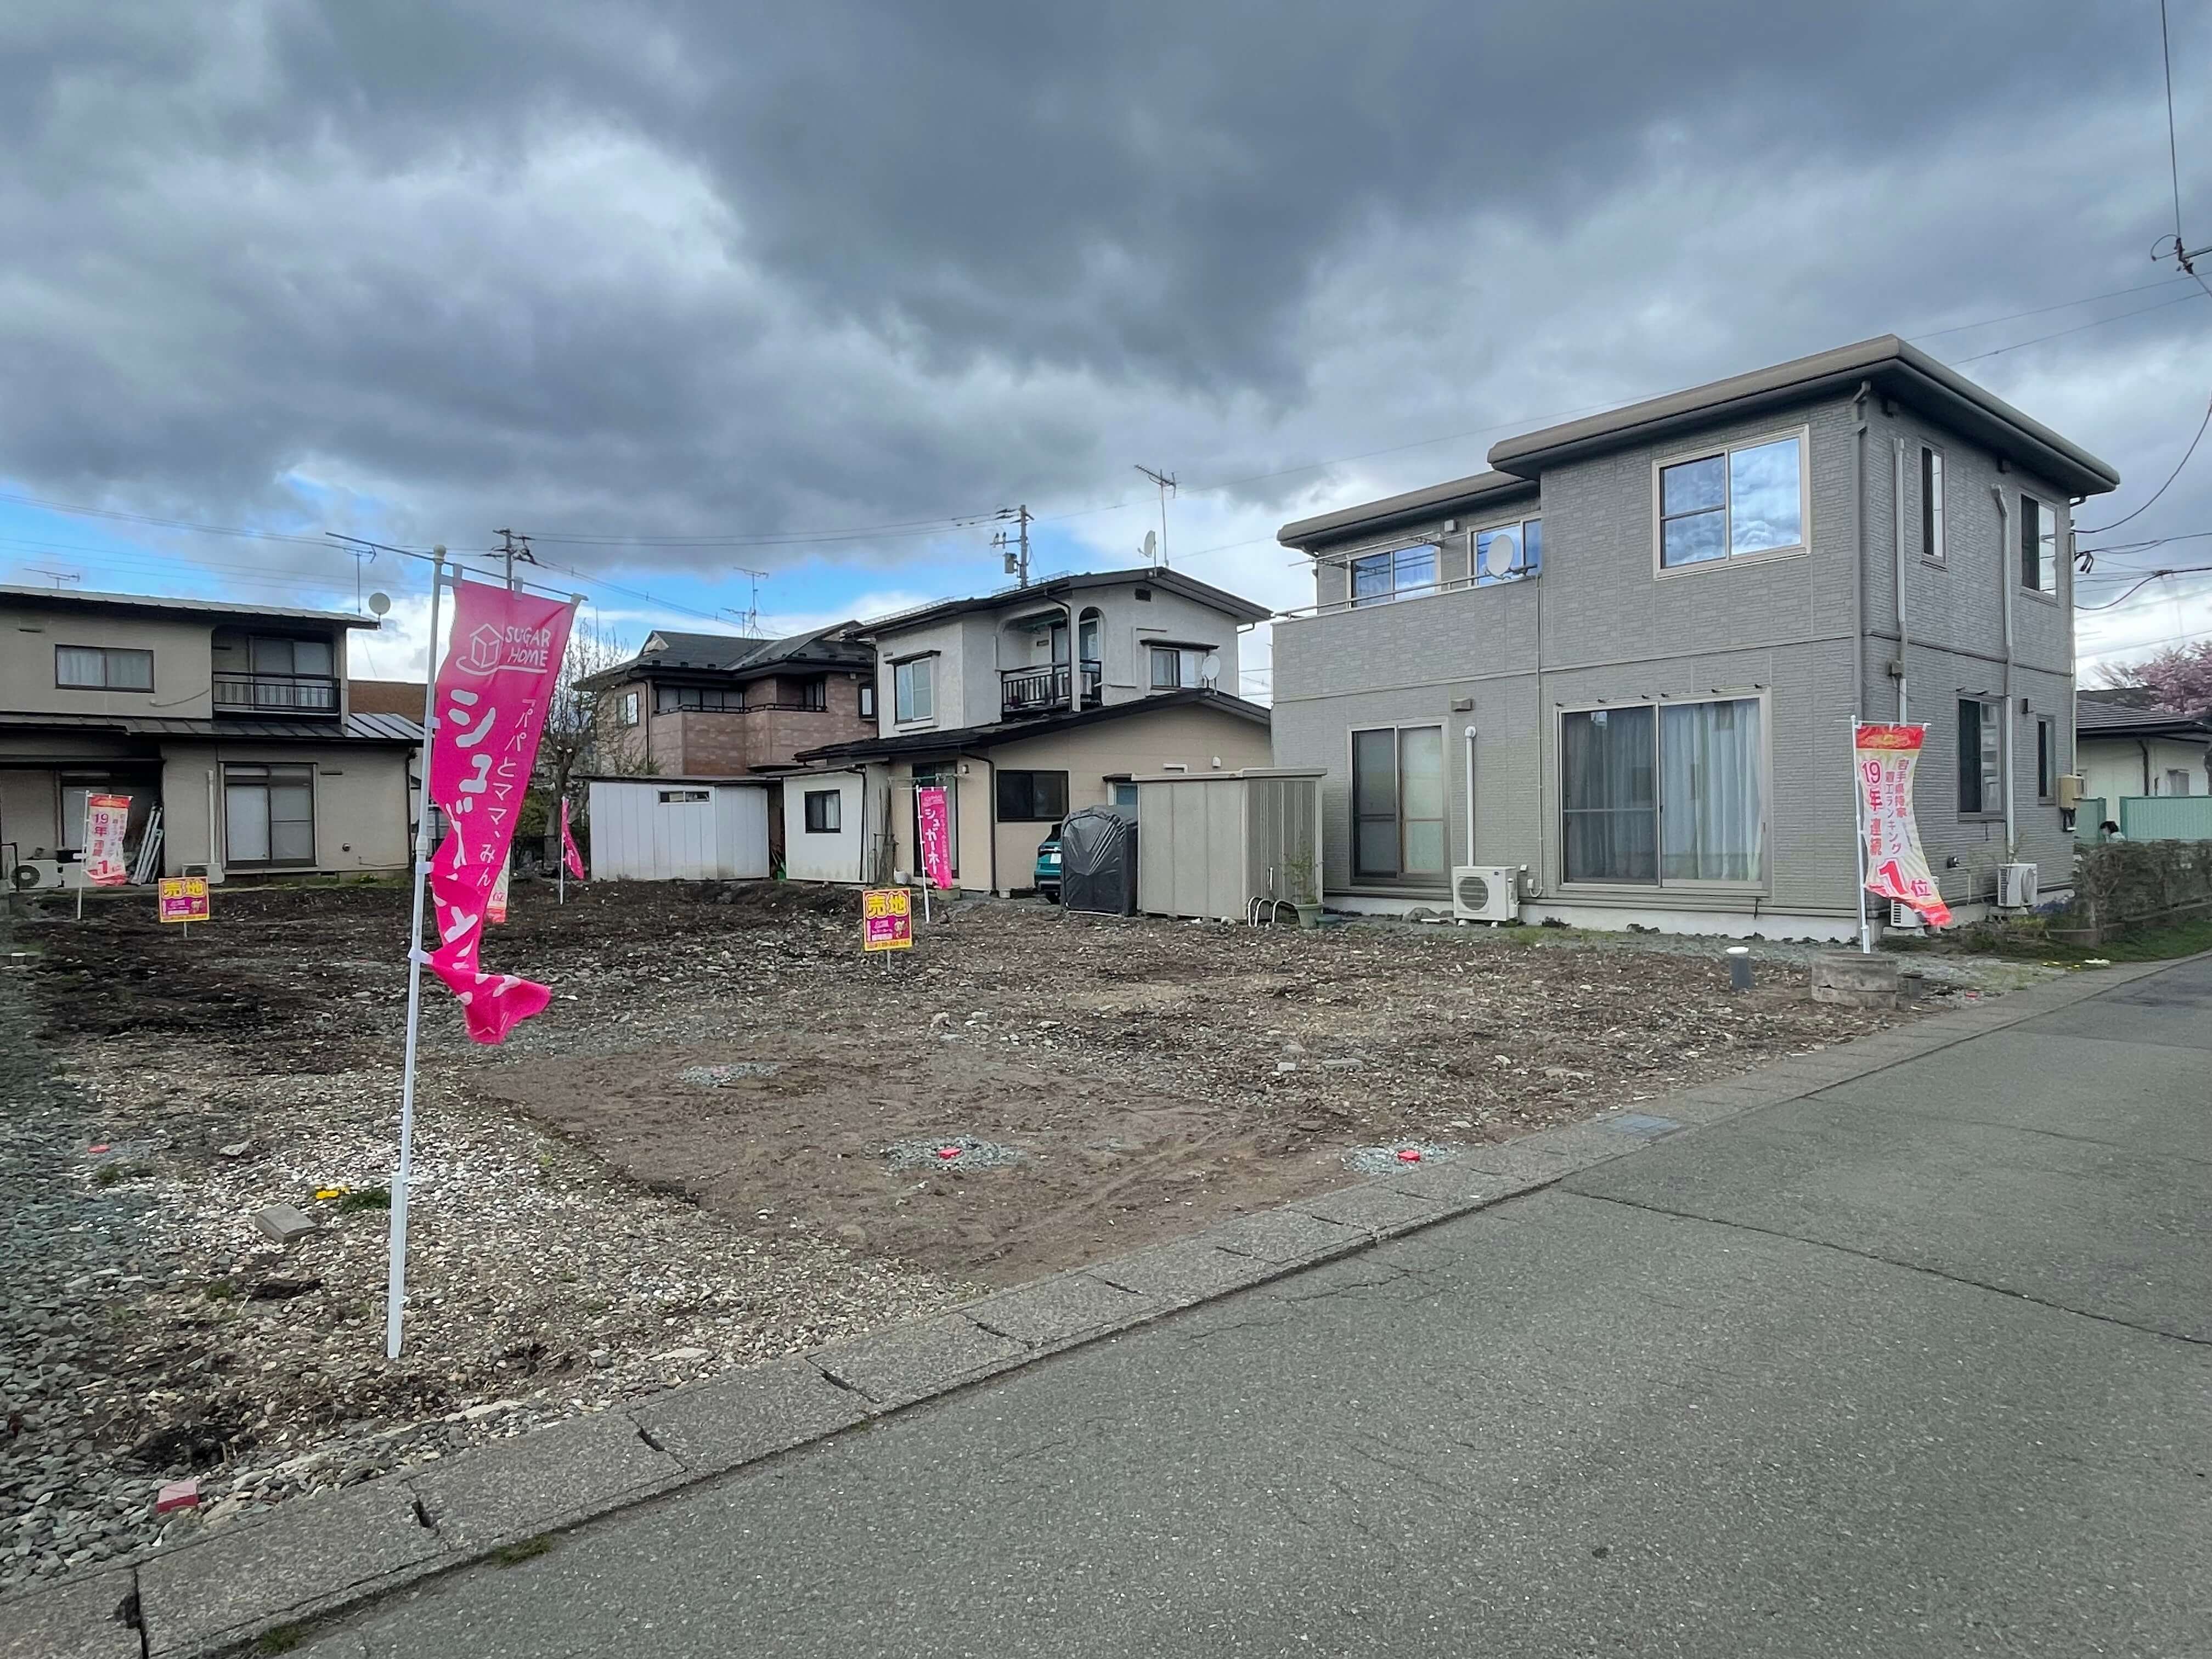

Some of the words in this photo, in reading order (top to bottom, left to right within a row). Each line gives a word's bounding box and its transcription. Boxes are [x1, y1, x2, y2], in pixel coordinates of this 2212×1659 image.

[504, 626, 551, 646] SUGAR
[508, 650, 549, 667] HOME
[162, 881, 204, 898] 売地
[867, 893, 907, 917] 売地
